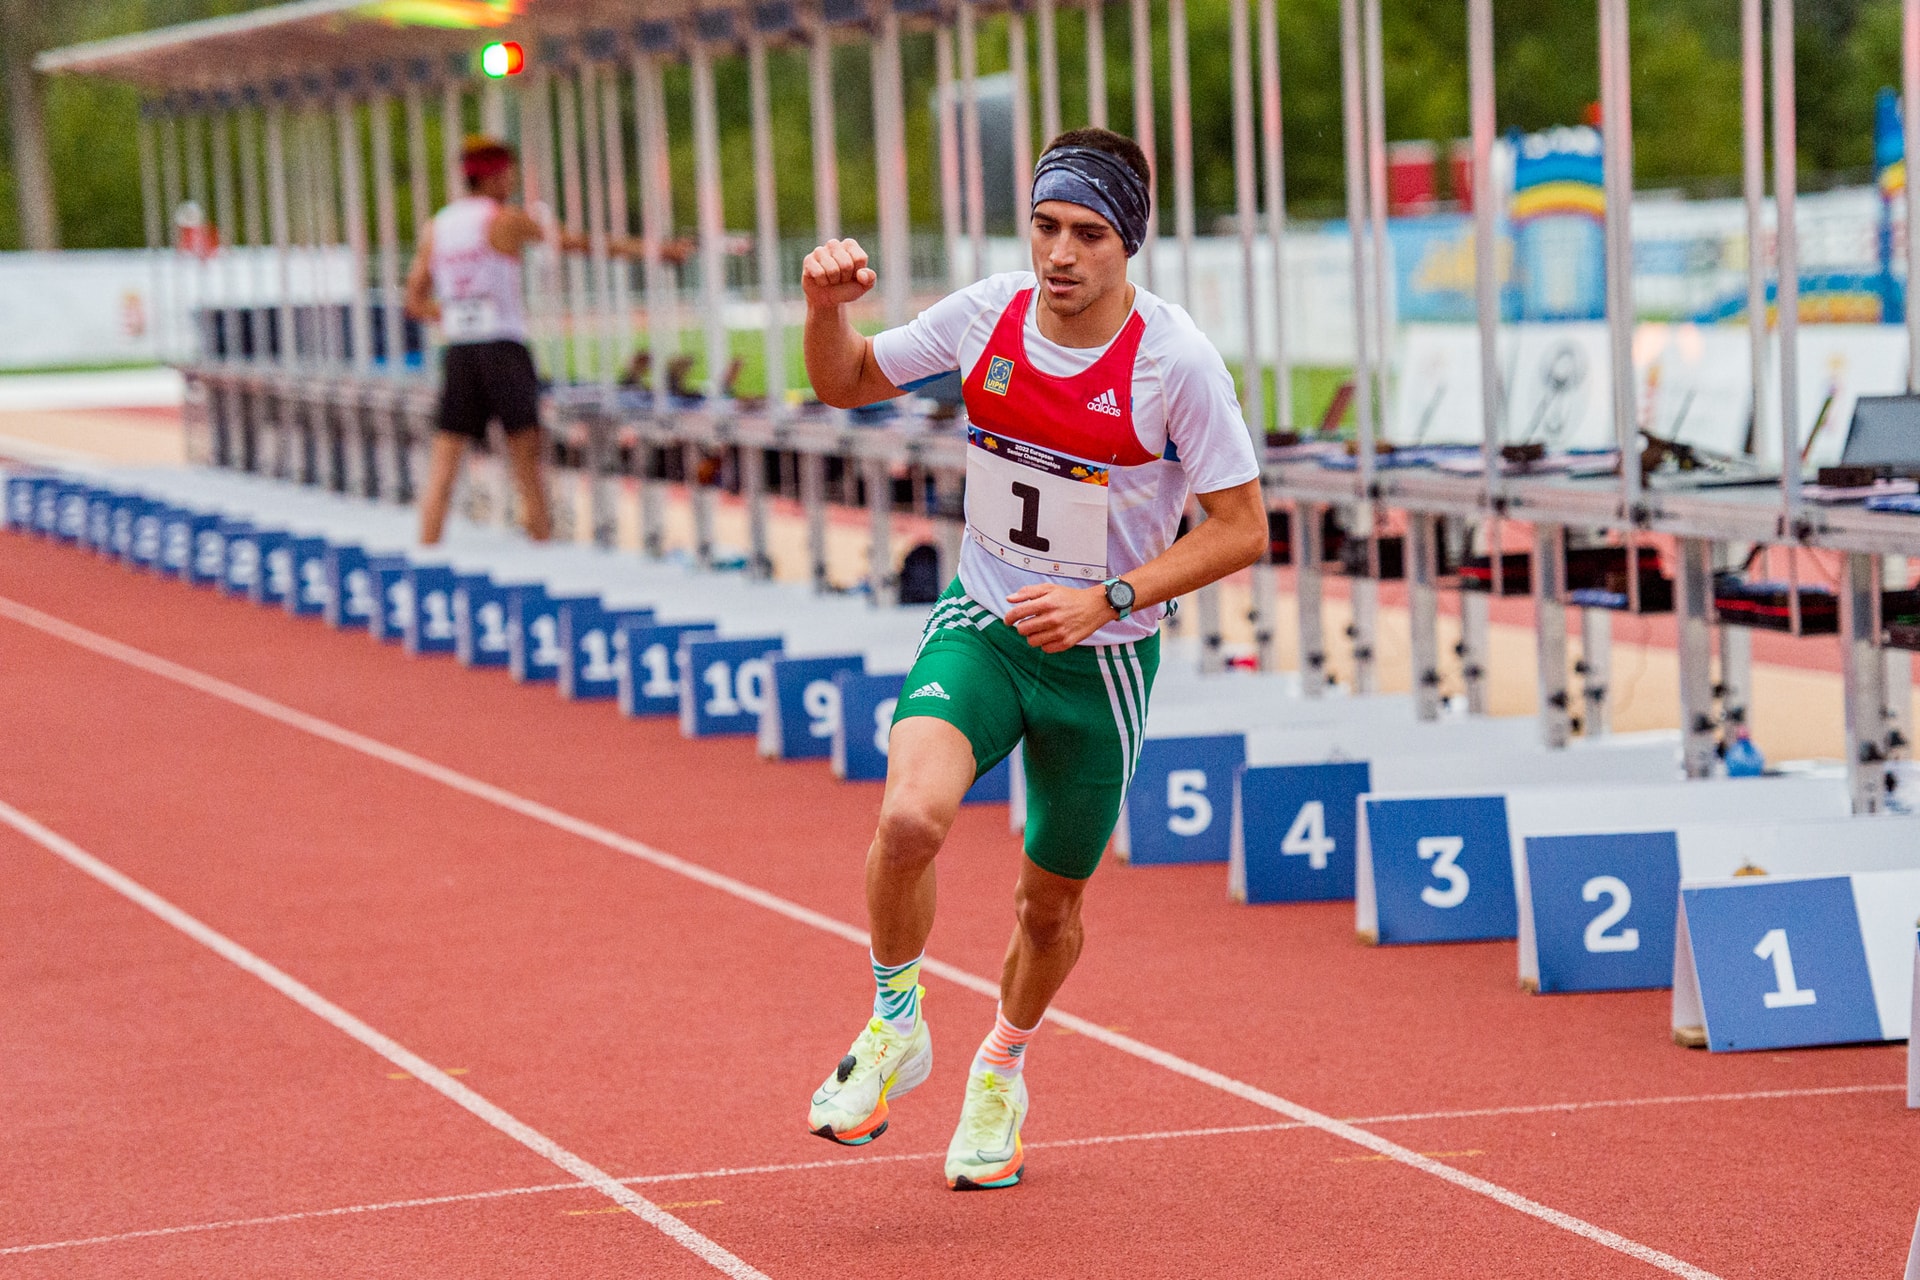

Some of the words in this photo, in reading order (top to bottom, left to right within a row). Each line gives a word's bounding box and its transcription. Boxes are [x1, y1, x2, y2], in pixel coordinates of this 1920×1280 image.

[988, 379, 1006, 390] UIPM
[1087, 401, 1121, 417] adidas
[1007, 447, 1024, 457] Senior
[1024, 453, 1061, 470] Championships
[1015, 444, 1030, 453] 2022
[1030, 448, 1054, 461] European
[1009, 481, 1050, 553] 1
[581, 629, 628, 681] 1
[642, 643, 689, 697] 1
[704, 658, 769, 717] 10
[803, 680, 842, 739] 9
[909, 689, 950, 700] adidas
[1168, 769, 1213, 836] 5
[1281, 800, 1336, 870] 4
[1417, 836, 1470, 908] 3
[1582, 875, 1640, 953] 2
[1753, 928, 1817, 1009] 1
